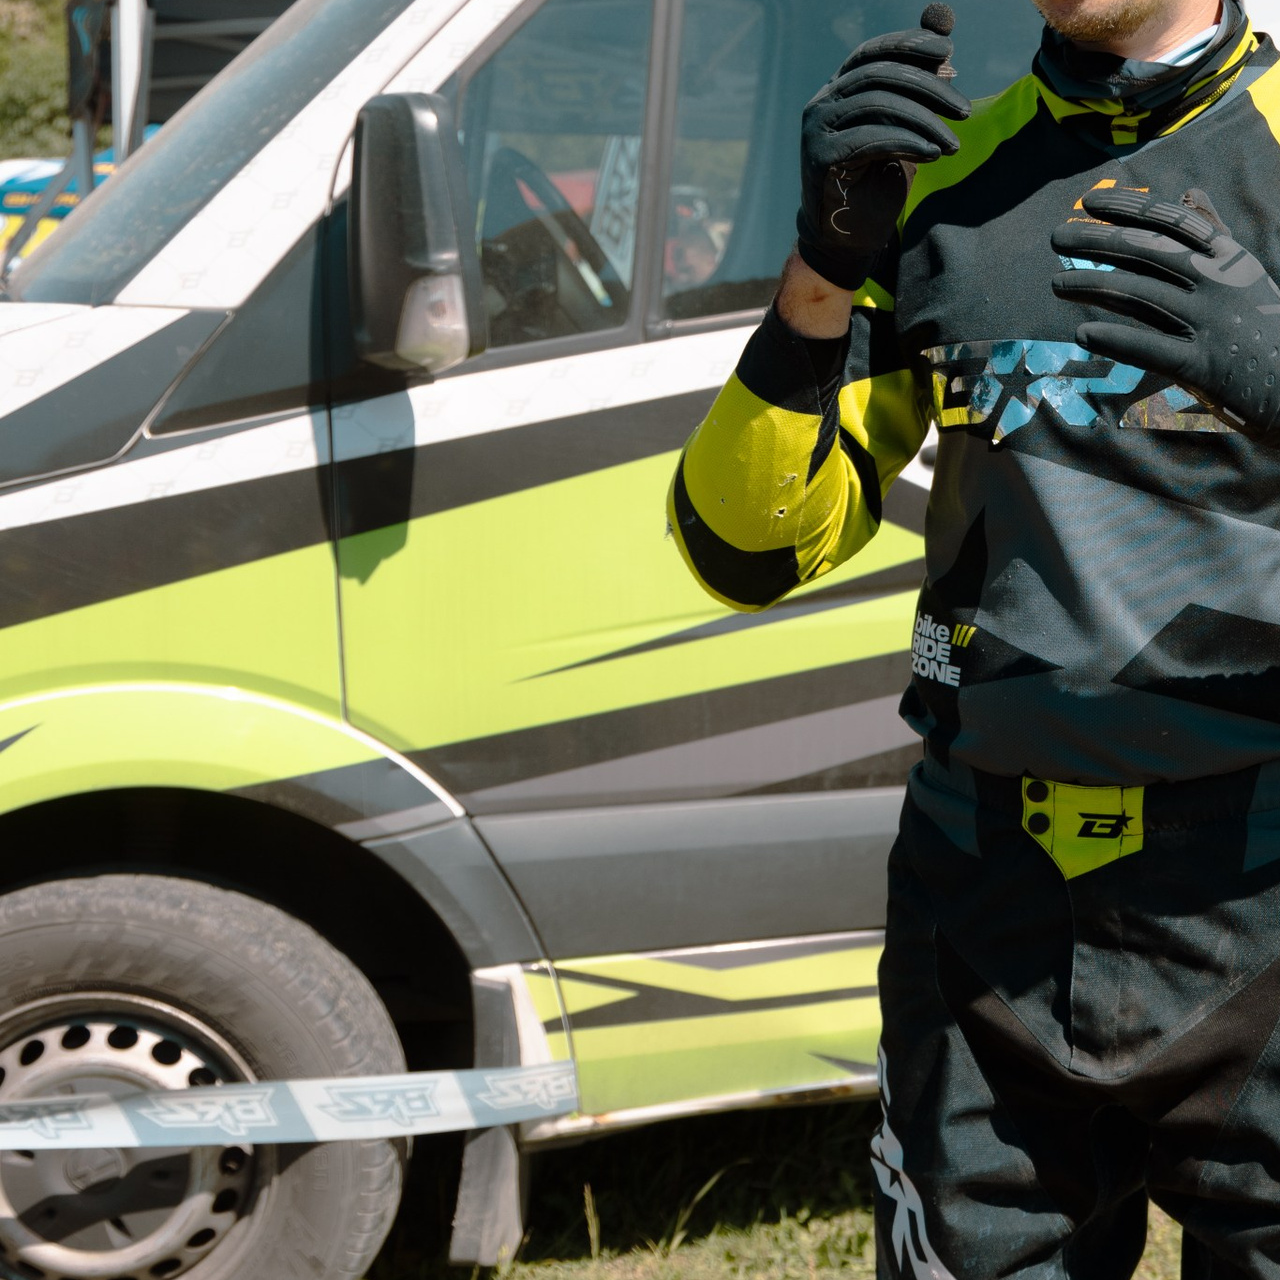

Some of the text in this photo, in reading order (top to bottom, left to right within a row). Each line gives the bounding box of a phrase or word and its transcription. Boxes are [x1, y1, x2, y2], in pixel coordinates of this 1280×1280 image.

[915, 611, 950, 642] bike
[912, 632, 951, 663] RIDE
[912, 652, 961, 687] ZONE
